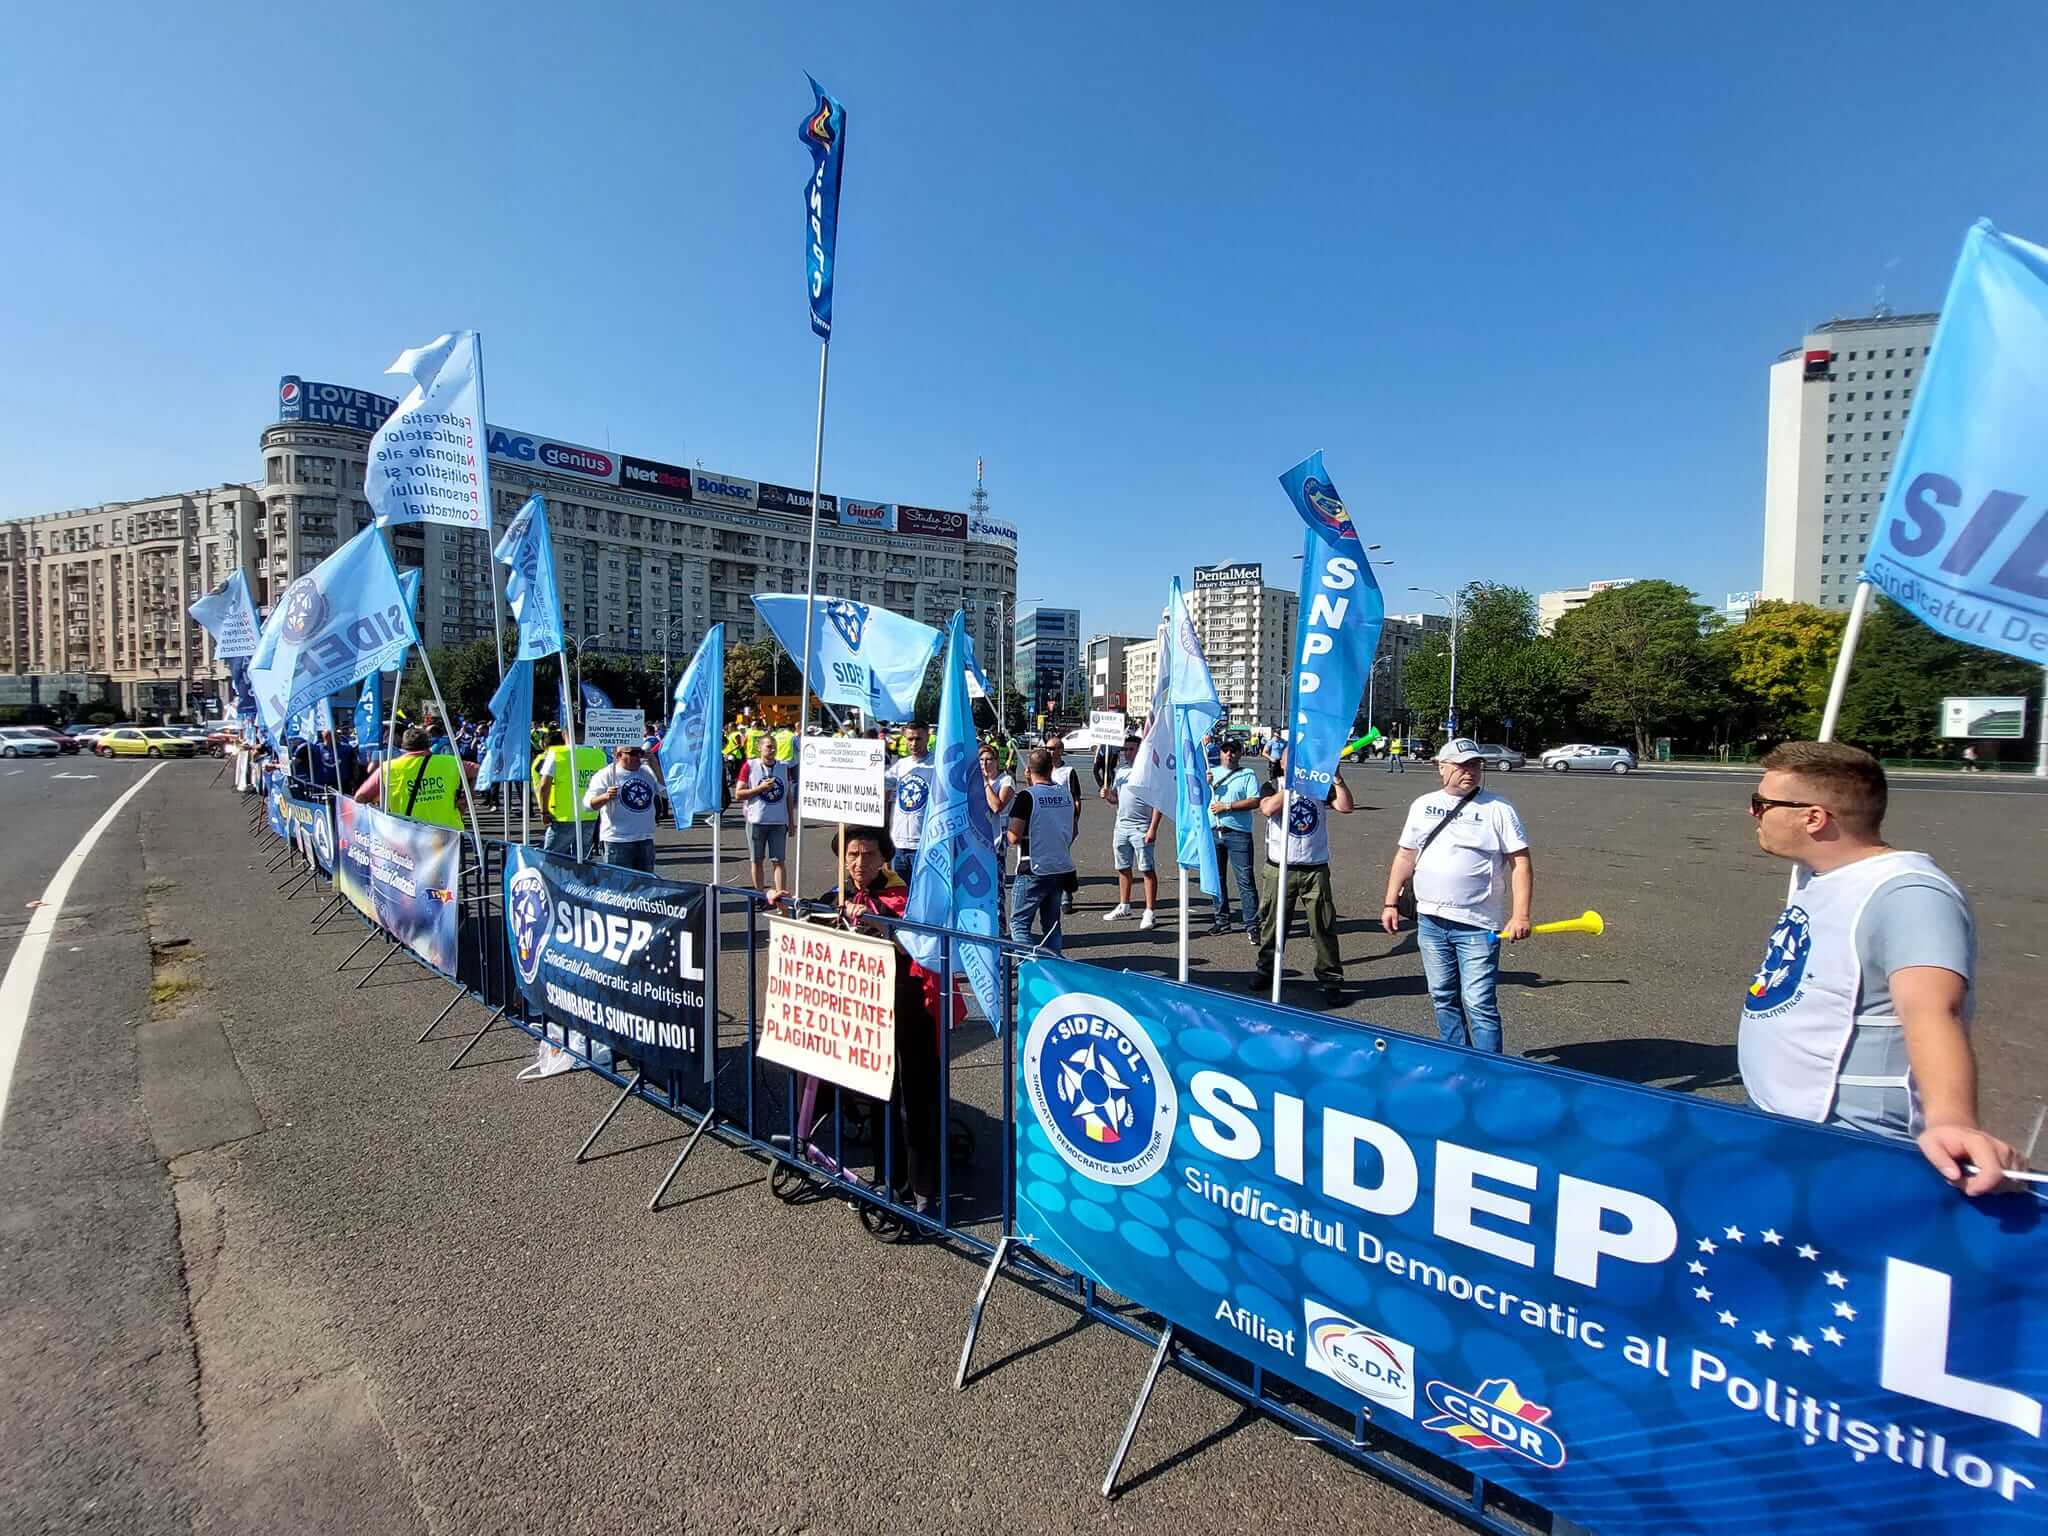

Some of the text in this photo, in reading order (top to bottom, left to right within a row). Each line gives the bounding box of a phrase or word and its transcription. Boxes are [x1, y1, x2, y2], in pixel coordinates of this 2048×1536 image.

[309, 384, 394, 414] LOVE IT
[309, 403, 385, 430] LIVE IT
[486, 429, 535, 461] AG
[546, 449, 606, 472] genius
[697, 477, 753, 499] BORSEC
[1195, 567, 1260, 582] DentalMed
[1872, 563, 1993, 634] Sindicatul
[407, 776, 444, 793] SPPC
[803, 796, 832, 809] PENTRU
[805, 781, 834, 793] PENTRU
[836, 783, 853, 794] UNII
[543, 949, 584, 978] Sindicatul
[580, 960, 630, 992] Democratic
[631, 981, 643, 997] al
[769, 974, 791, 998] DIN
[778, 952, 882, 1001] INFRACTORII
[546, 982, 605, 1029] SCHIMBAREA
[605, 1006, 656, 1046] SUNTEM
[766, 1019, 842, 1060] PLAGIATUL
[1058, 1016, 1144, 1072] SIDEPOL
[1032, 1073, 1058, 1135] SINDICATUL
[1056, 1132, 1110, 1174] DEMOCRATIC
[1111, 1166, 1123, 1176] AL
[1185, 1166, 1348, 1254] Sindicatul
[1357, 1230, 1606, 1351] Democratic
[1622, 1335, 1671, 1378] al
[1214, 1299, 1296, 1358] Afiliat
[1332, 1344, 1408, 1391] F.S.D.R.
[1443, 1394, 1545, 1458] CSDR
